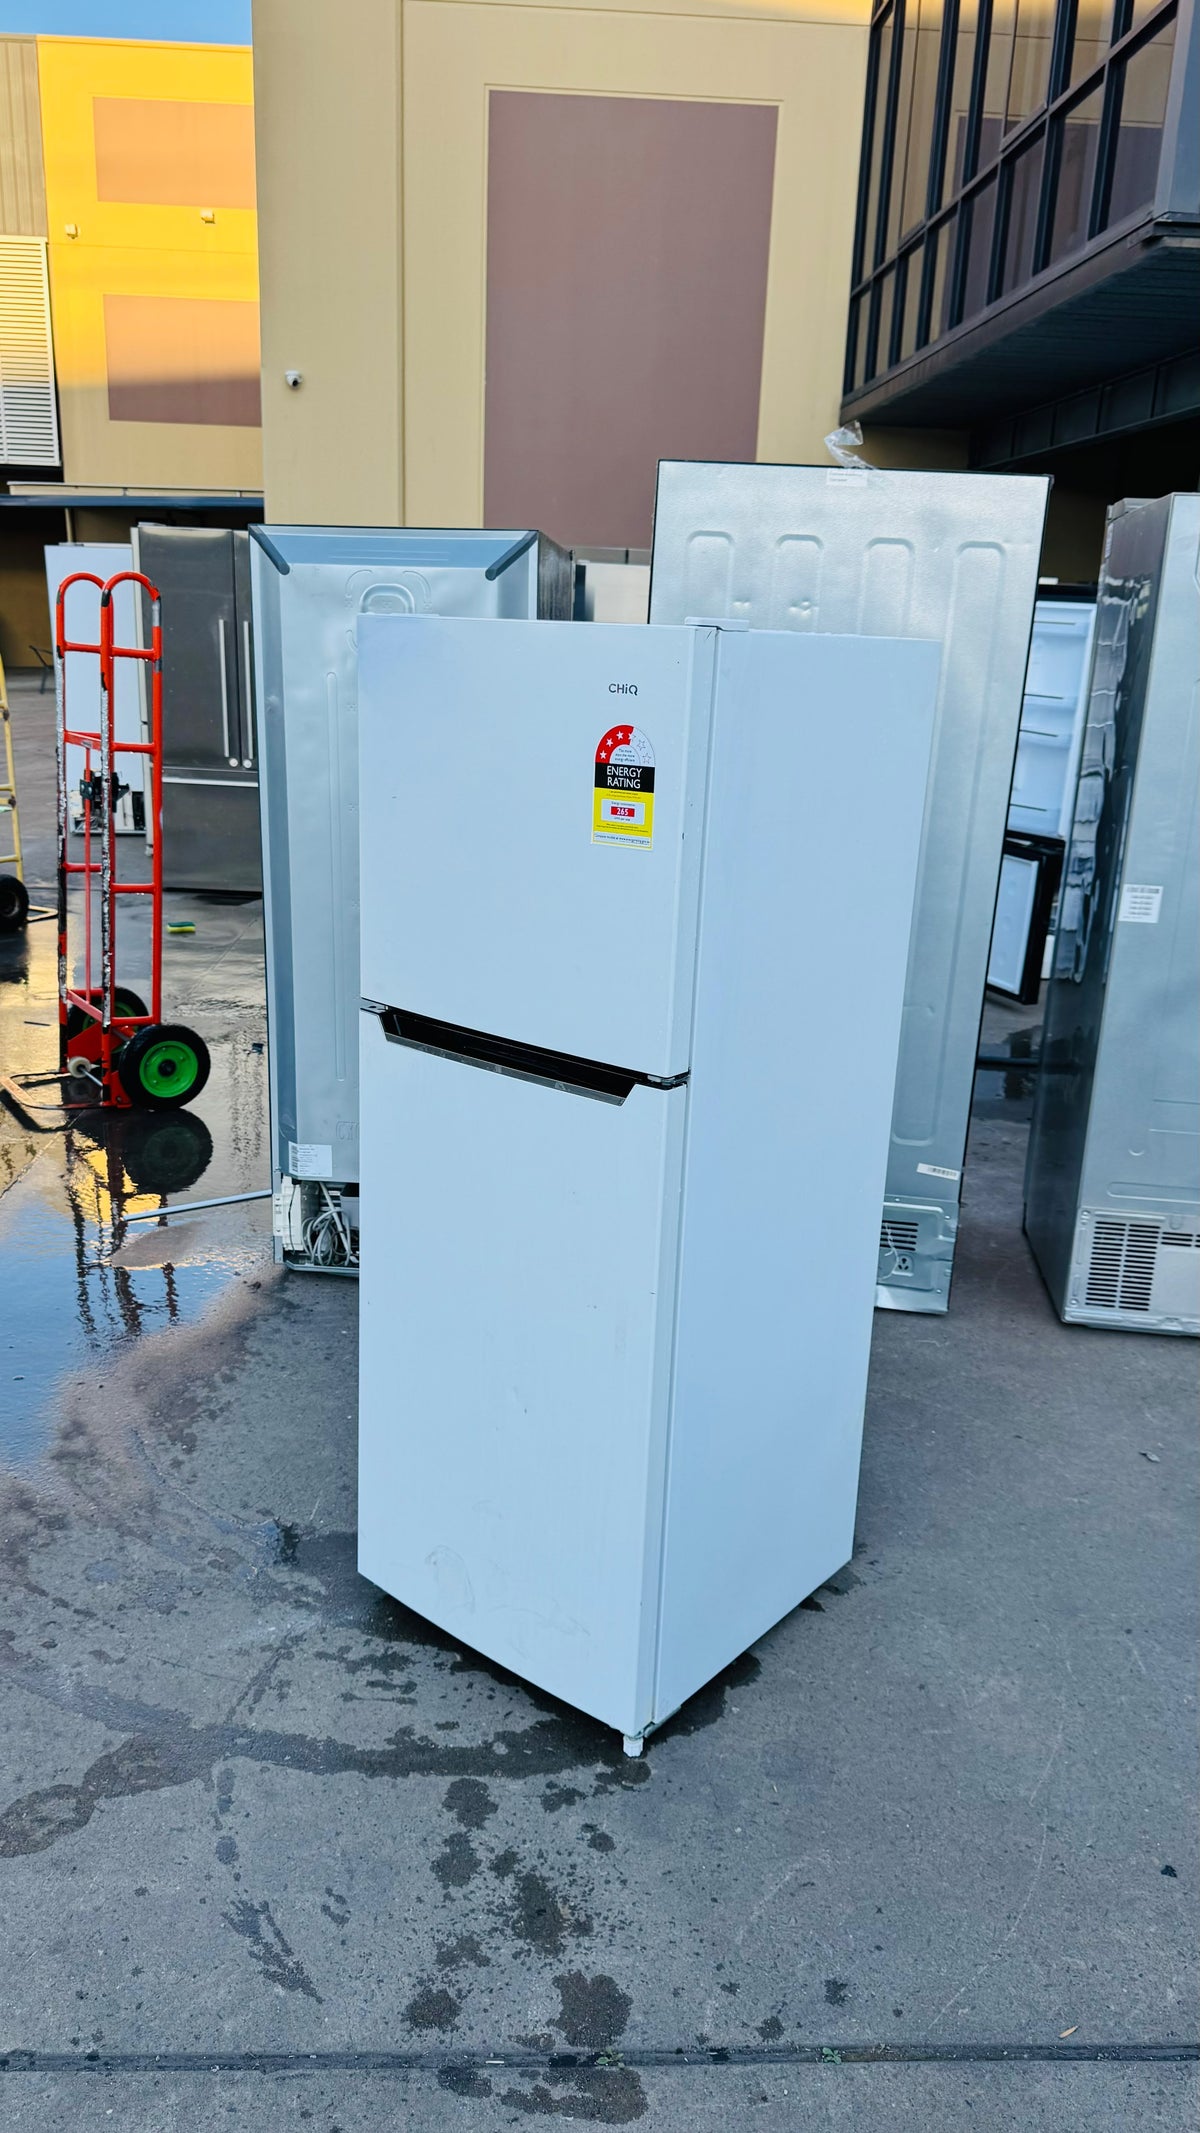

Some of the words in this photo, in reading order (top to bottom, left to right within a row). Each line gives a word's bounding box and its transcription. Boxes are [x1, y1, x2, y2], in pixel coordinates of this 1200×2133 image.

[608, 683, 638, 696] CHiQ
[606, 765, 642, 778] ENERGY
[607, 777, 641, 789] RATING
[616, 807, 629, 816] 265
